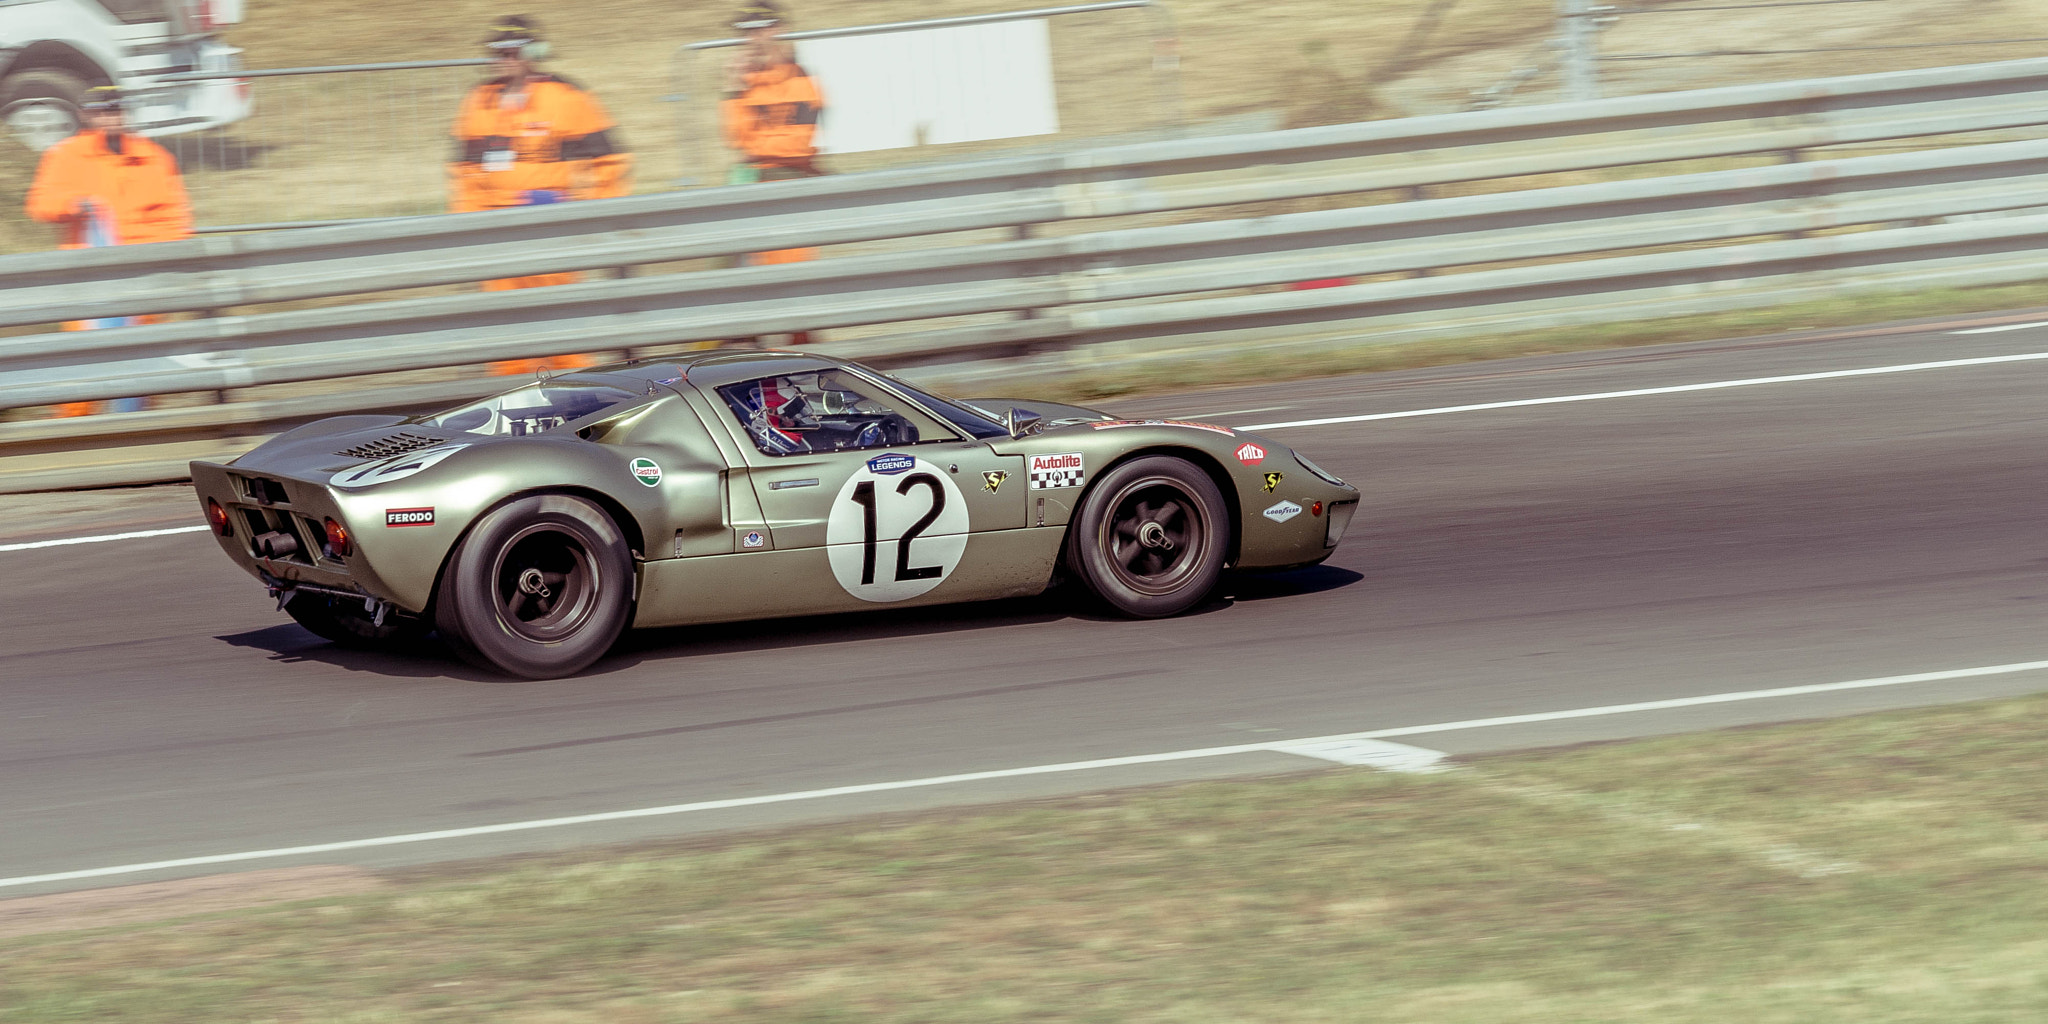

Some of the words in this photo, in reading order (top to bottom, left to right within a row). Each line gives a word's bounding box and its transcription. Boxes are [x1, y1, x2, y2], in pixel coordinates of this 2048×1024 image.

[1237, 444, 1264, 460] TRICO
[871, 460, 912, 471] LEGENDS
[1033, 455, 1081, 470] Autolite
[388, 512, 433, 523] FERODO
[850, 472, 946, 586] 12
